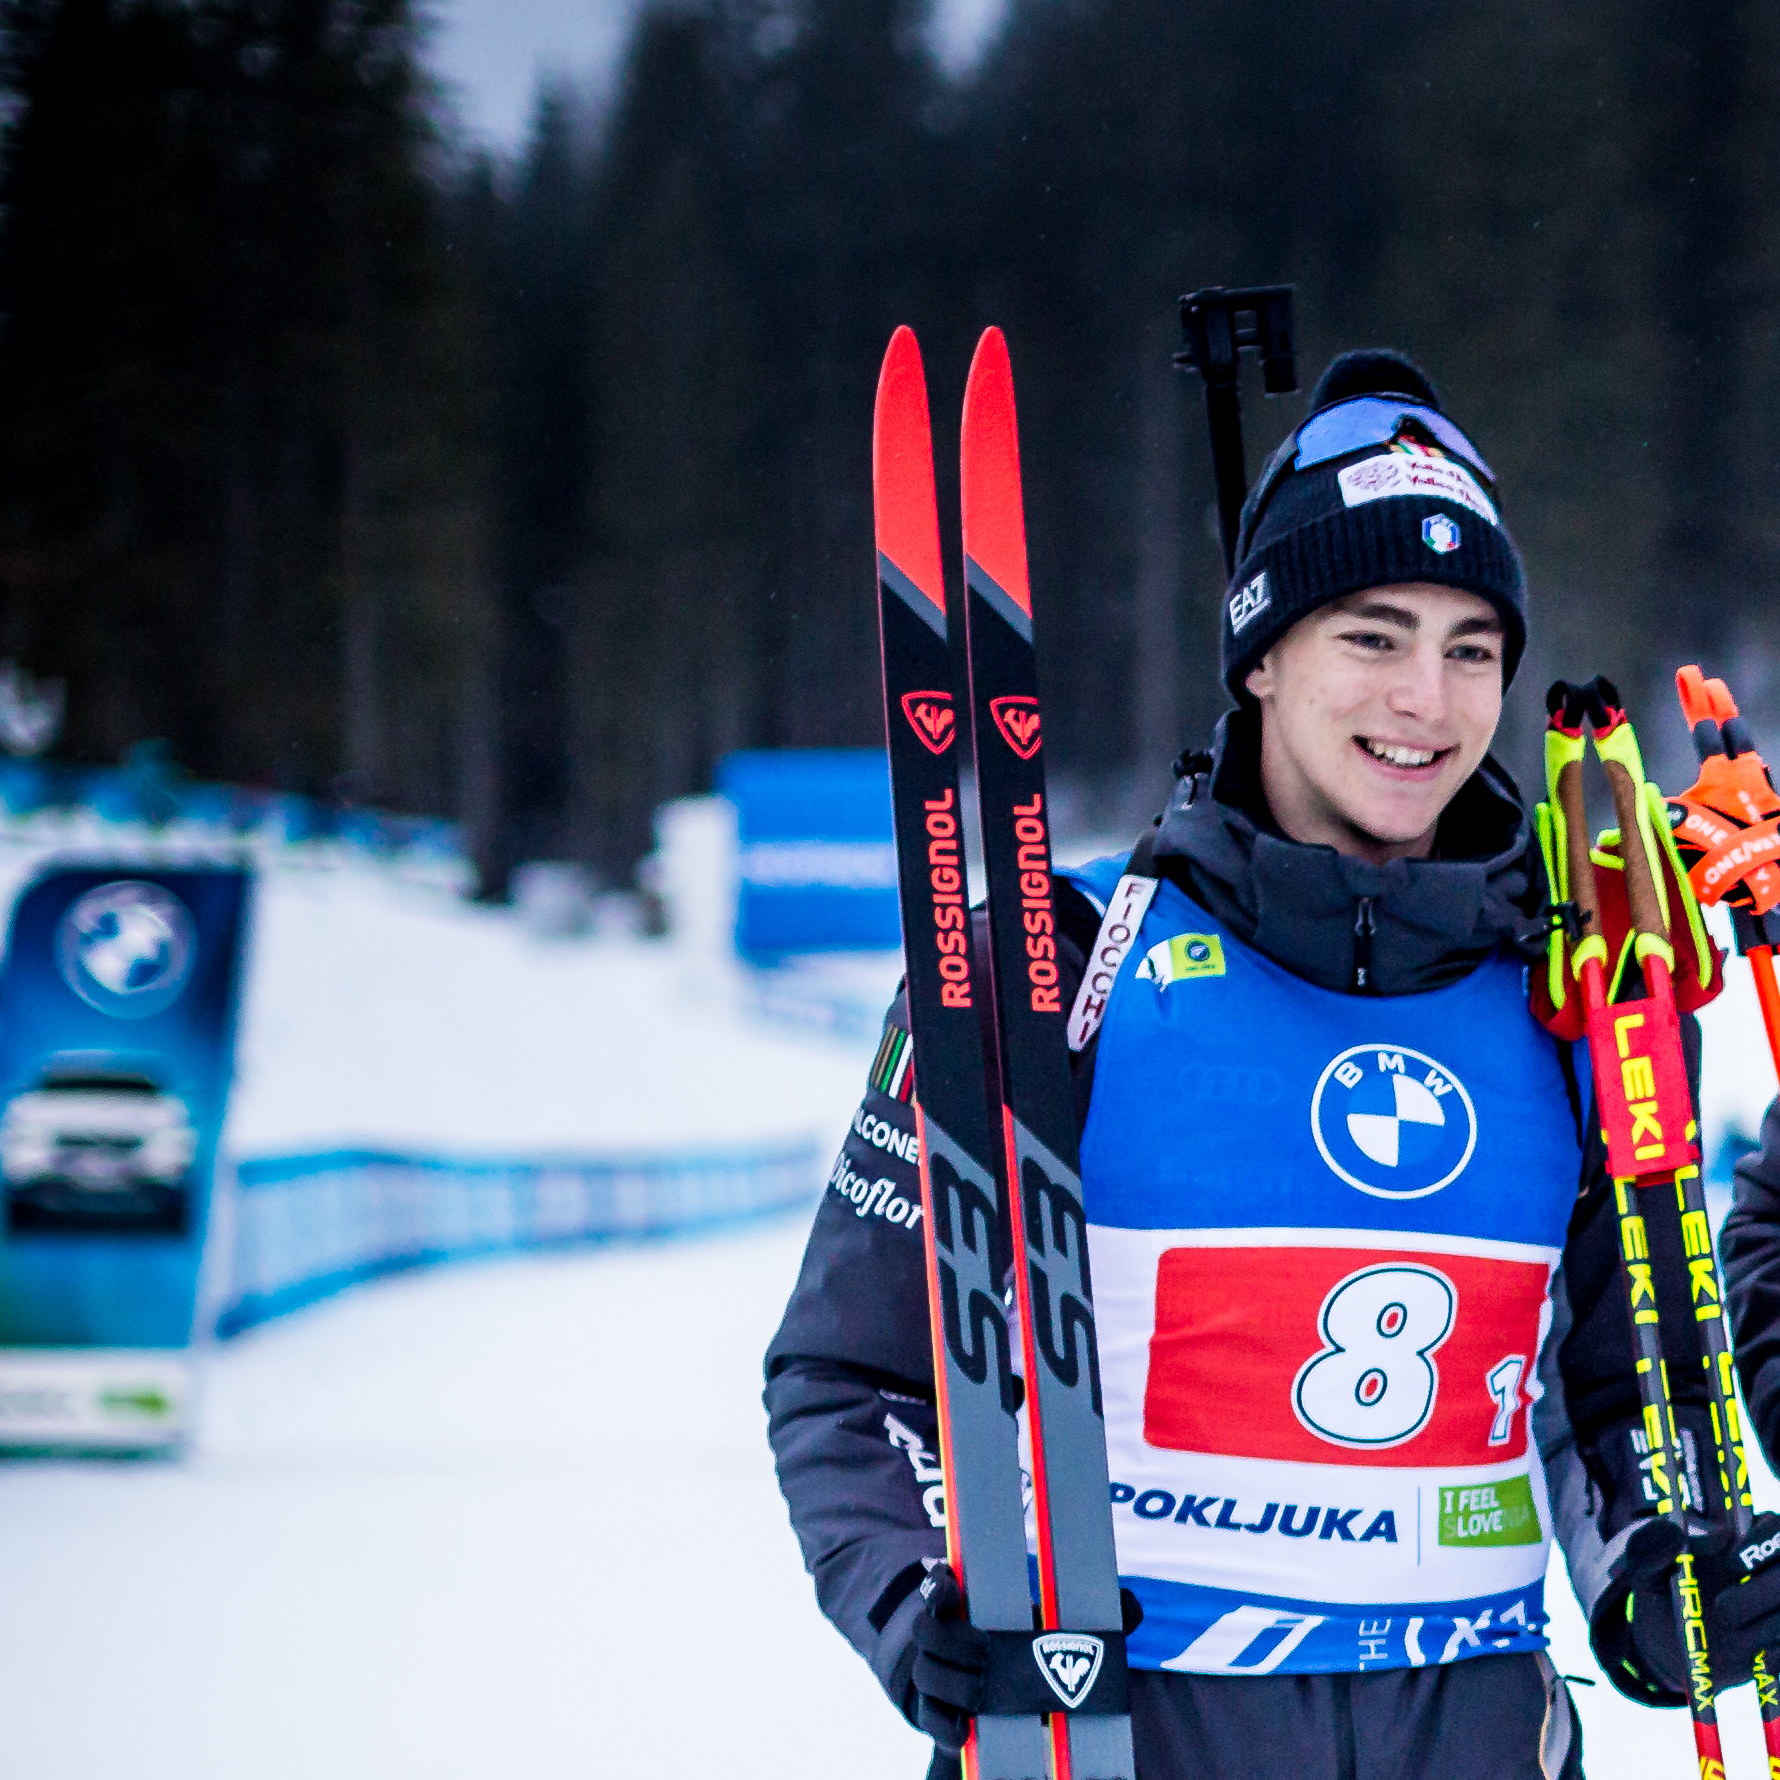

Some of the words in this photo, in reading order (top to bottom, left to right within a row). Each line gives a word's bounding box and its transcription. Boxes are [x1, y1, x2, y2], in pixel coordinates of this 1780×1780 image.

[1229, 572, 1269, 624] EA7
[924, 788, 972, 1009] ROSSIGNOL
[1013, 793, 1061, 1013] ROSSIGNOL
[1078, 882, 1146, 1044] FIOCCHI
[1335, 1052, 1453, 1098] BMW
[1614, 1013, 1667, 1162] LEKI
[1614, 1177, 1659, 1326] LEKI
[1674, 1164, 1721, 1322] LEKI
[1294, 1263, 1456, 1449] 8
[1487, 1356, 1529, 1447] 1
[1109, 1482, 1399, 1543] POKLJUKA
[1458, 1486, 1501, 1513] FEEL
[1676, 1552, 1715, 1712] HRCMAX
